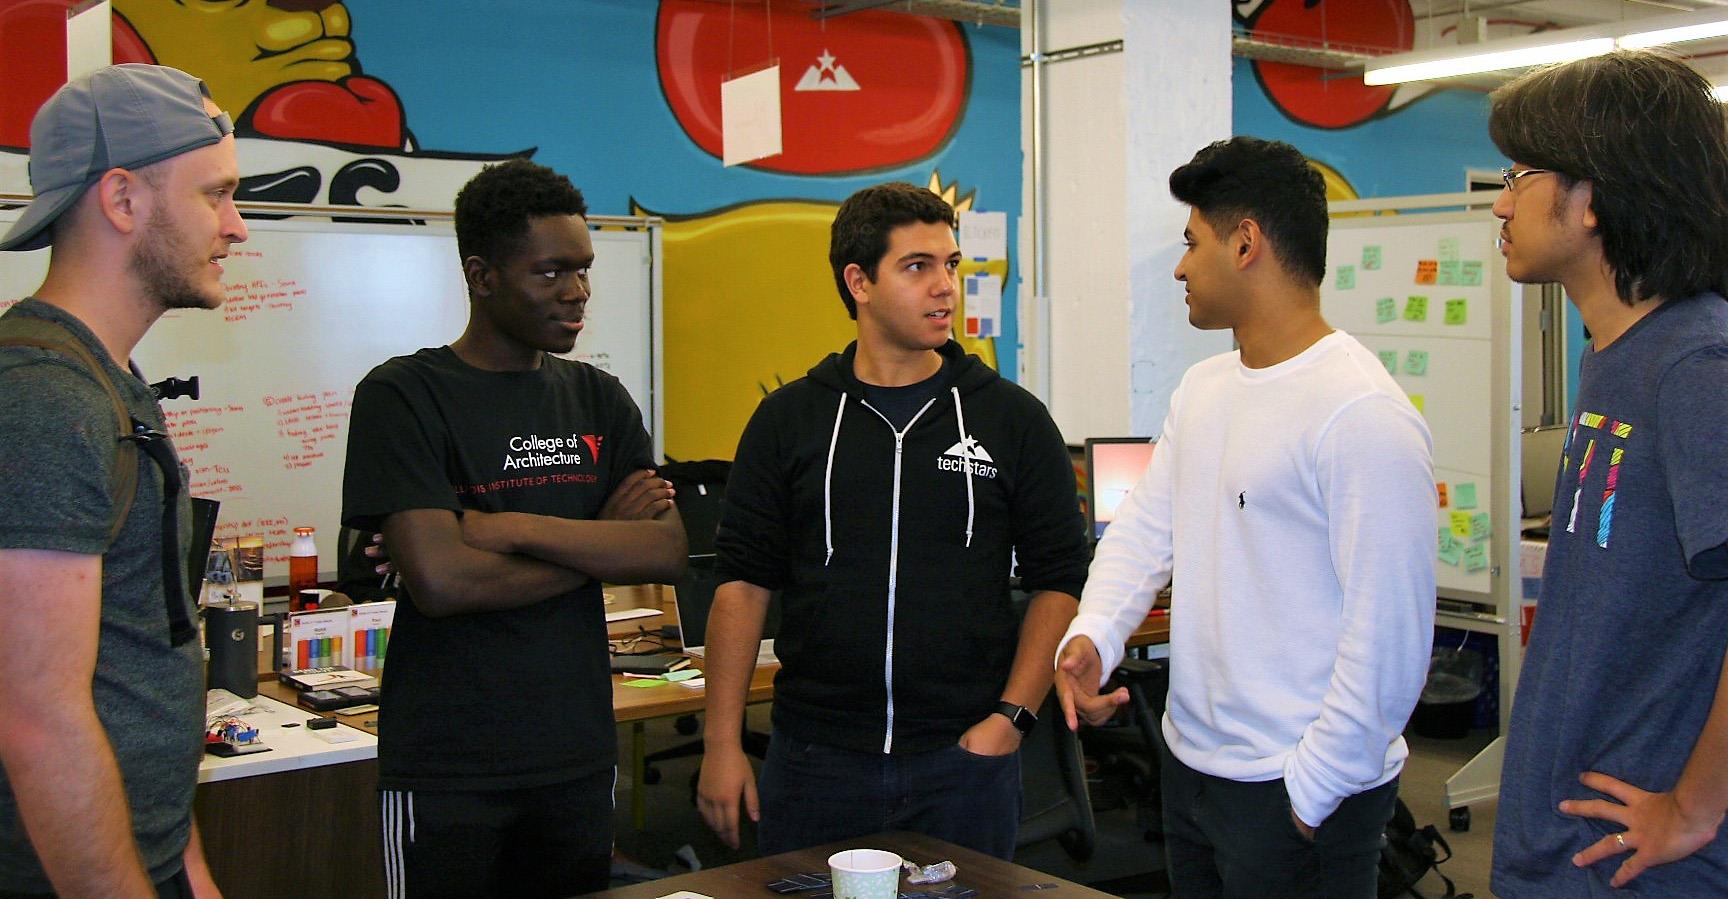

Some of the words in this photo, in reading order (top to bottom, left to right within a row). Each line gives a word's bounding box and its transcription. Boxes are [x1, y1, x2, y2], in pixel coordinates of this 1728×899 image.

[510, 435, 564, 453] College
[566, 433, 578, 449] of
[503, 452, 581, 471] Architecture
[936, 456, 998, 479] techstars
[489, 477, 534, 491] INSTITUTE
[536, 475, 548, 485] OF
